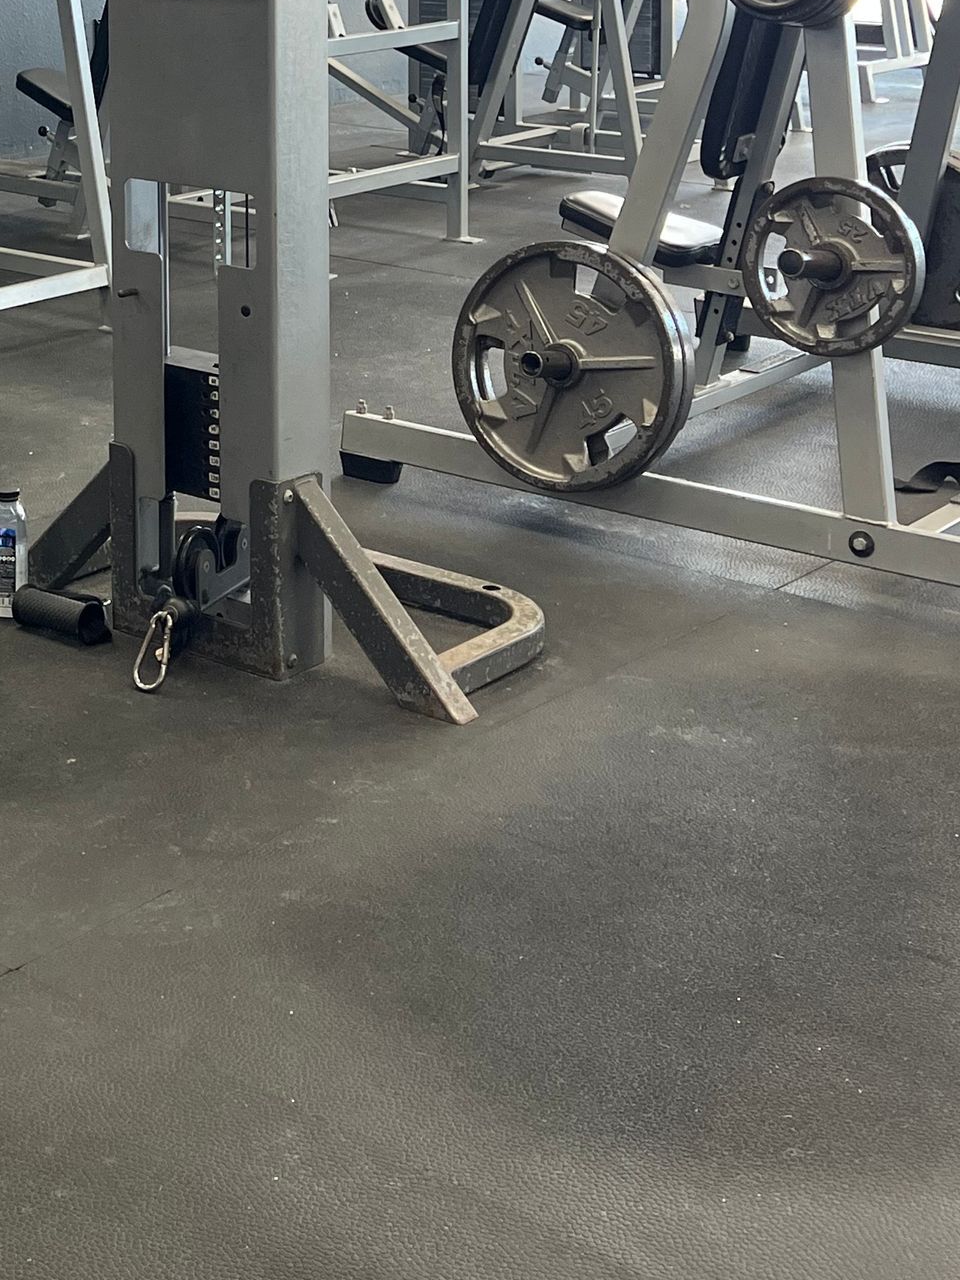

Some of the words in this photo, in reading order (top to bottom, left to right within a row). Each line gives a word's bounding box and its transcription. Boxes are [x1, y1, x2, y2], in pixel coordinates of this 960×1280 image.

[836, 219, 869, 244] 25
[564, 299, 609, 337] 45
[576, 388, 615, 431] 45
